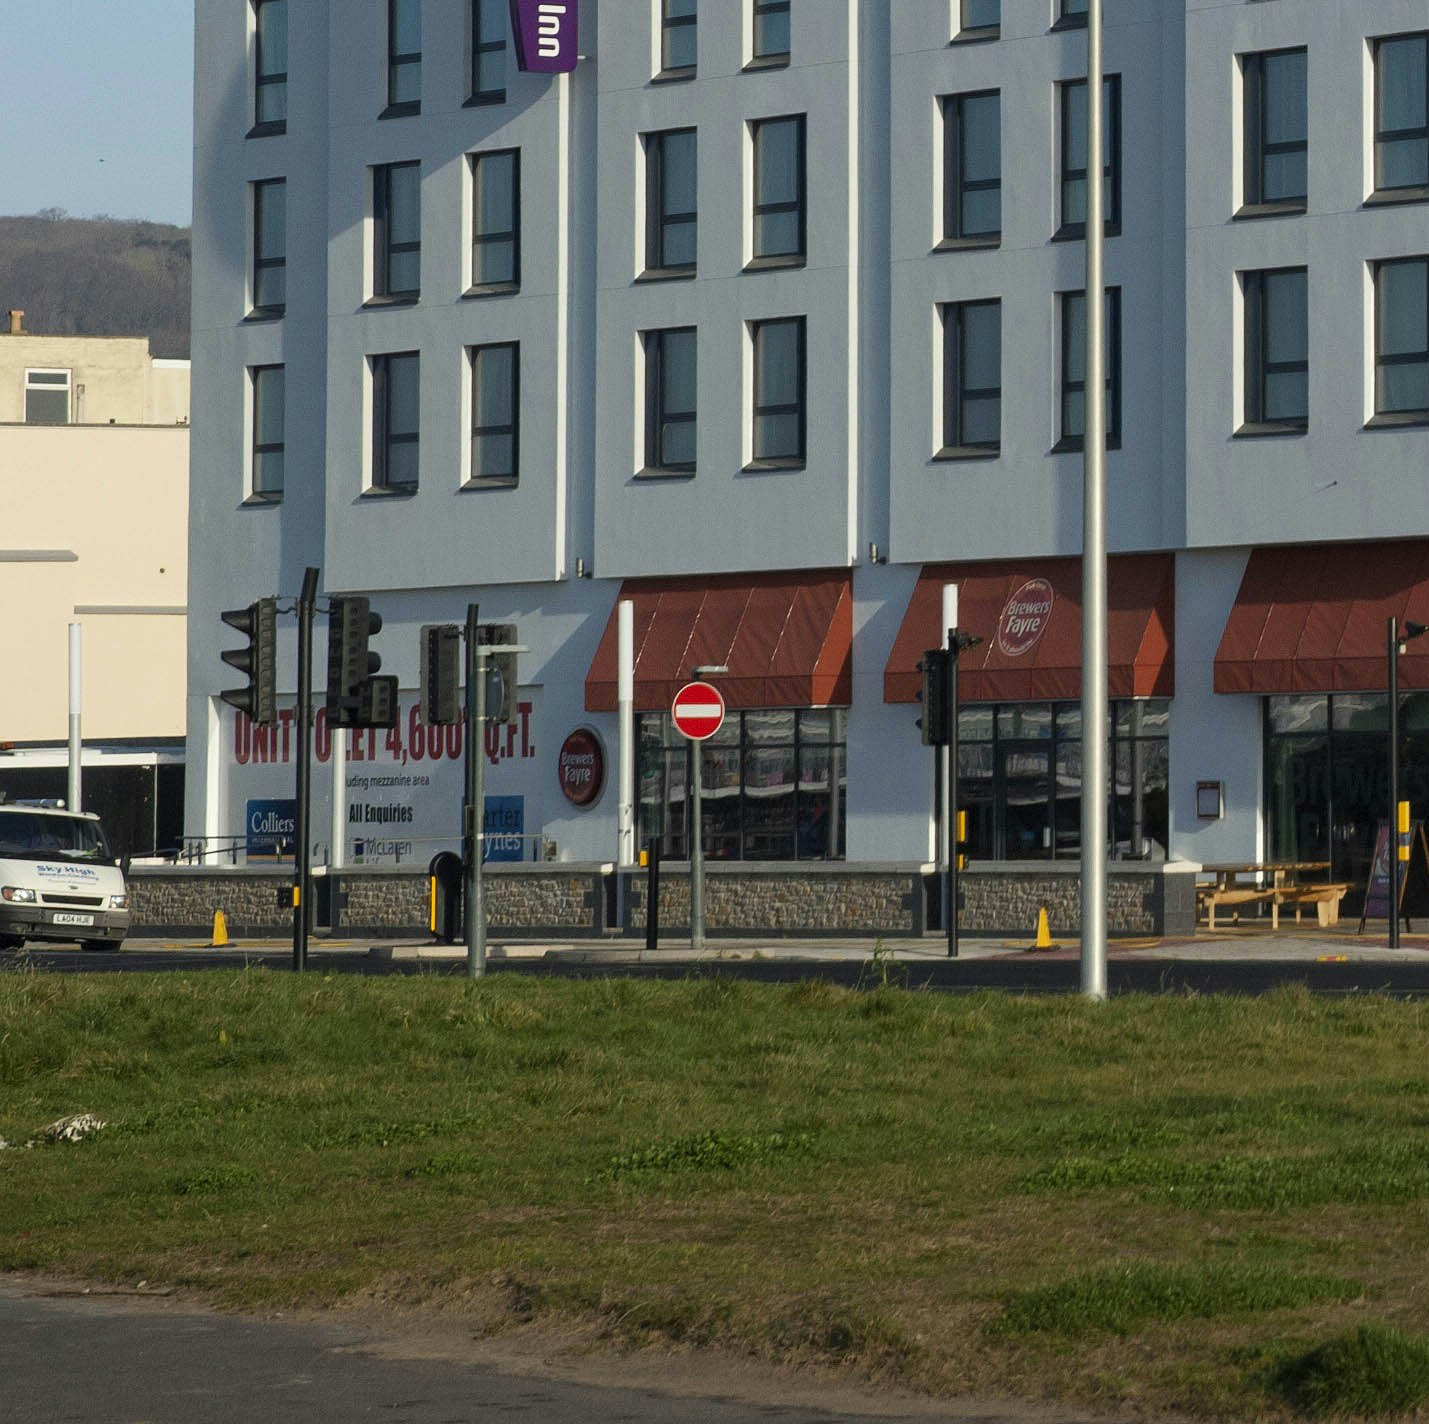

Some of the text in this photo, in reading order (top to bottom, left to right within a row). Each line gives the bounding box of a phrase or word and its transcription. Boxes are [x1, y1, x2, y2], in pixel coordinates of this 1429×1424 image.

[538, 4, 567, 58] Inn
[1007, 600, 1050, 615] Brewers
[1005, 616, 1041, 638] Fayre
[234, 708, 294, 764] UNIT
[482, 702, 536, 765] Q.FT.
[561, 751, 594, 766] Brewers
[370, 774, 411, 787] mezzanine
[412, 775, 430, 786] area
[565, 766, 592, 786] Fayre
[251, 811, 295, 833] Colliers
[349, 802, 414, 824] All Enquiries
